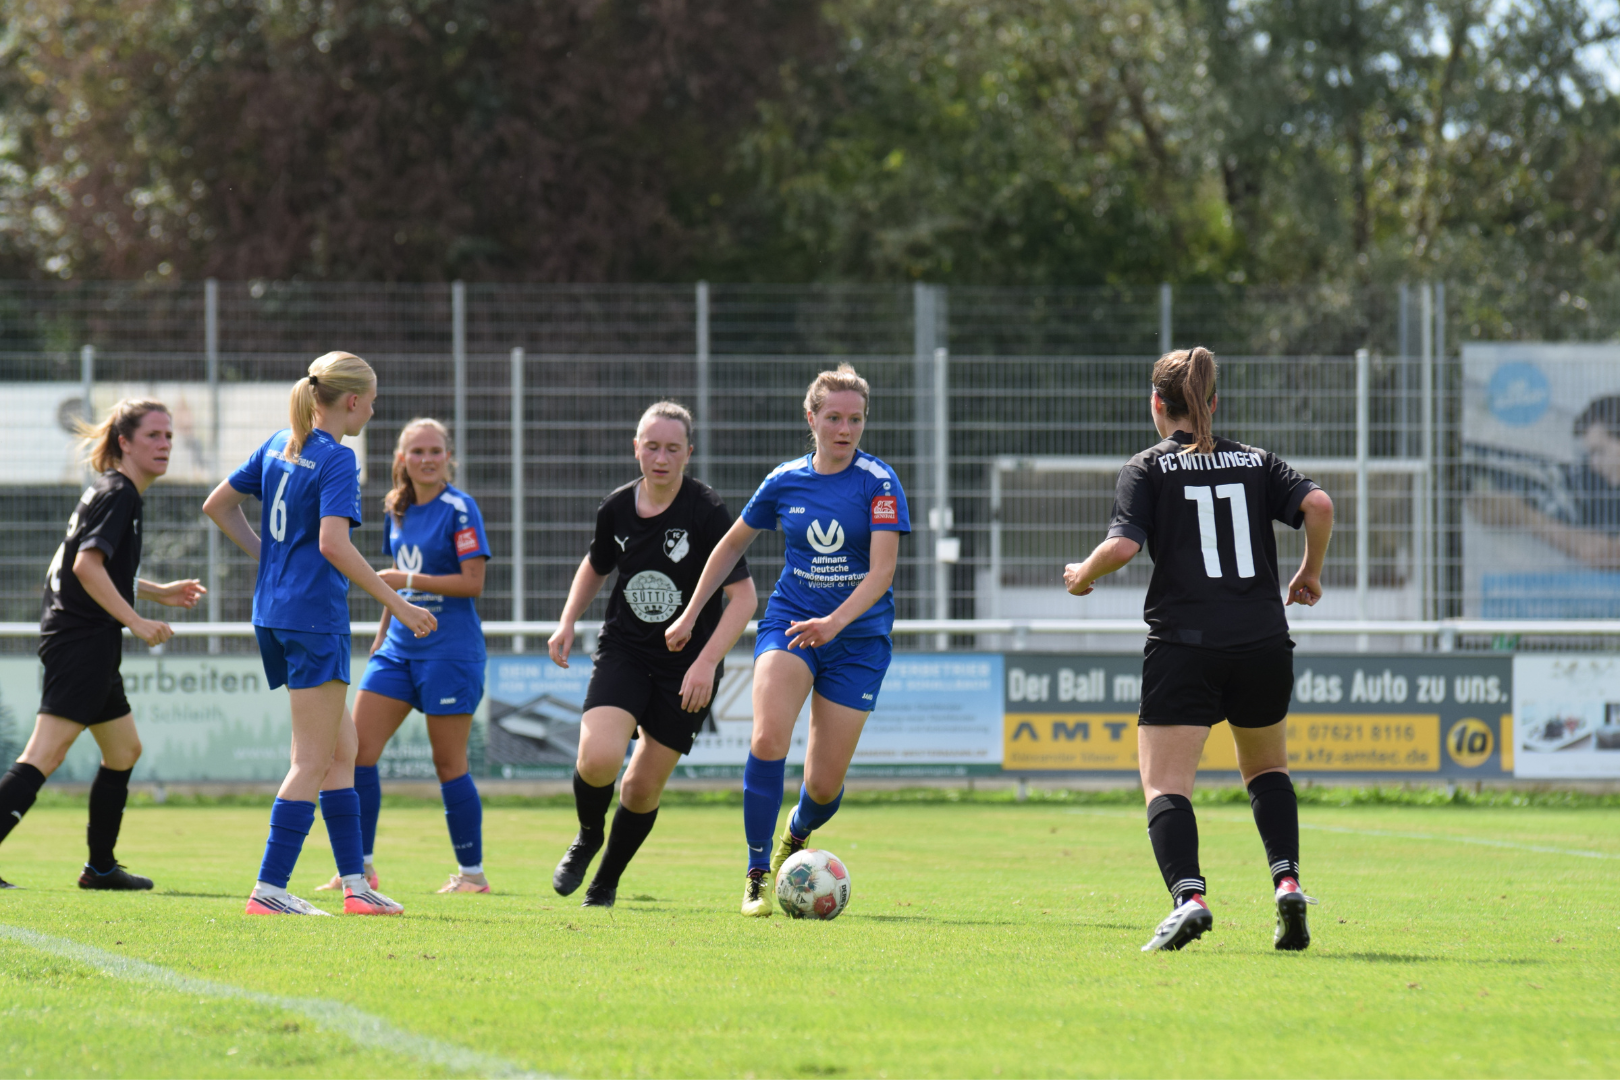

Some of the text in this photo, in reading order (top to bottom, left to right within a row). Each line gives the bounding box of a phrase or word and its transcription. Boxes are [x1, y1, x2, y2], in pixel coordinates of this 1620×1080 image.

[1158, 451, 1263, 474] FC WITTLINGEN
[269, 471, 287, 542] 6
[788, 506, 806, 514] JAKO
[1184, 482, 1256, 578] 11
[810, 564, 850, 573] Deutsche
[811, 556, 848, 564] Allfinanz
[1008, 668, 1051, 702] Der
[1057, 668, 1105, 702] Ball
[1295, 668, 1343, 703] das
[1351, 668, 1408, 703] Auto
[1416, 675, 1446, 703] zu
[1454, 675, 1508, 703] uns.
